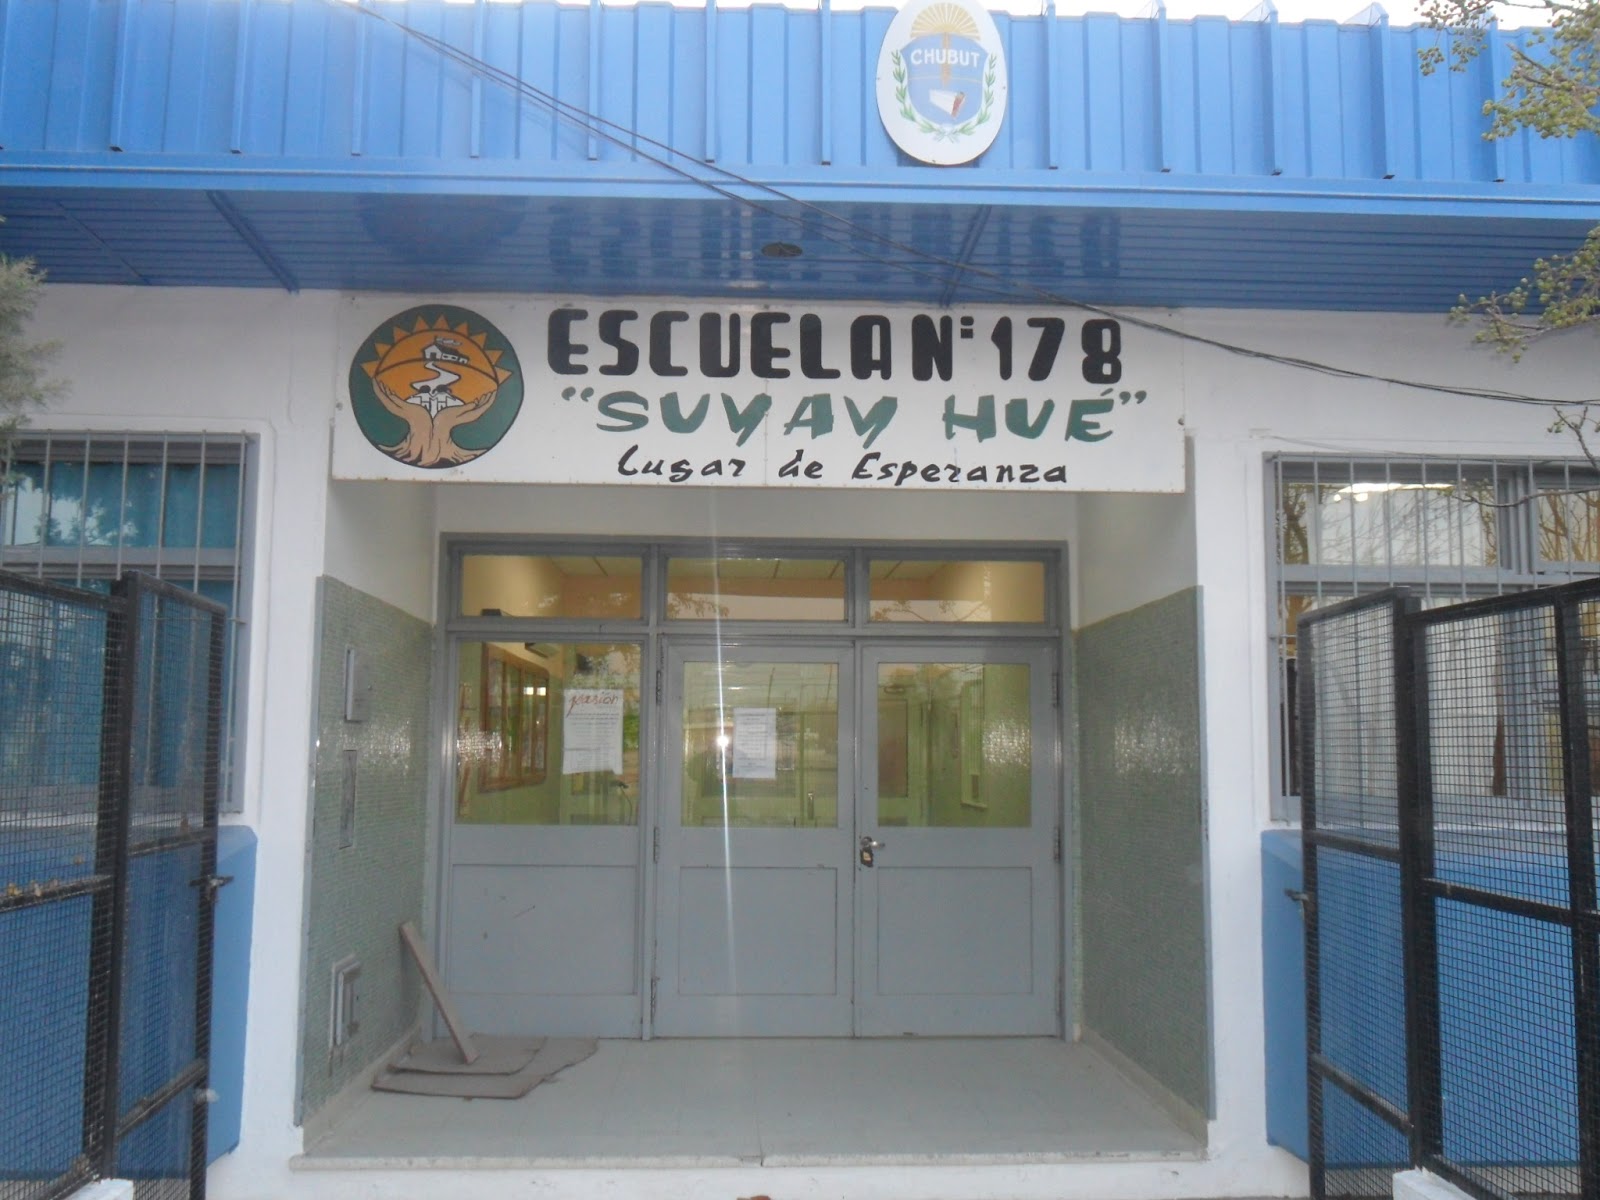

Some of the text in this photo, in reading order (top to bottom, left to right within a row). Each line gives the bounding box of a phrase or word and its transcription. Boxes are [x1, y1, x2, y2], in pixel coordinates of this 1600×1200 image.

[910, 48, 980, 68] CHUBUT
[547, 308, 892, 381] ESCUELA
[991, 316, 1122, 385] 178
[617, 444, 1067, 486] Lugar de Esperanza
